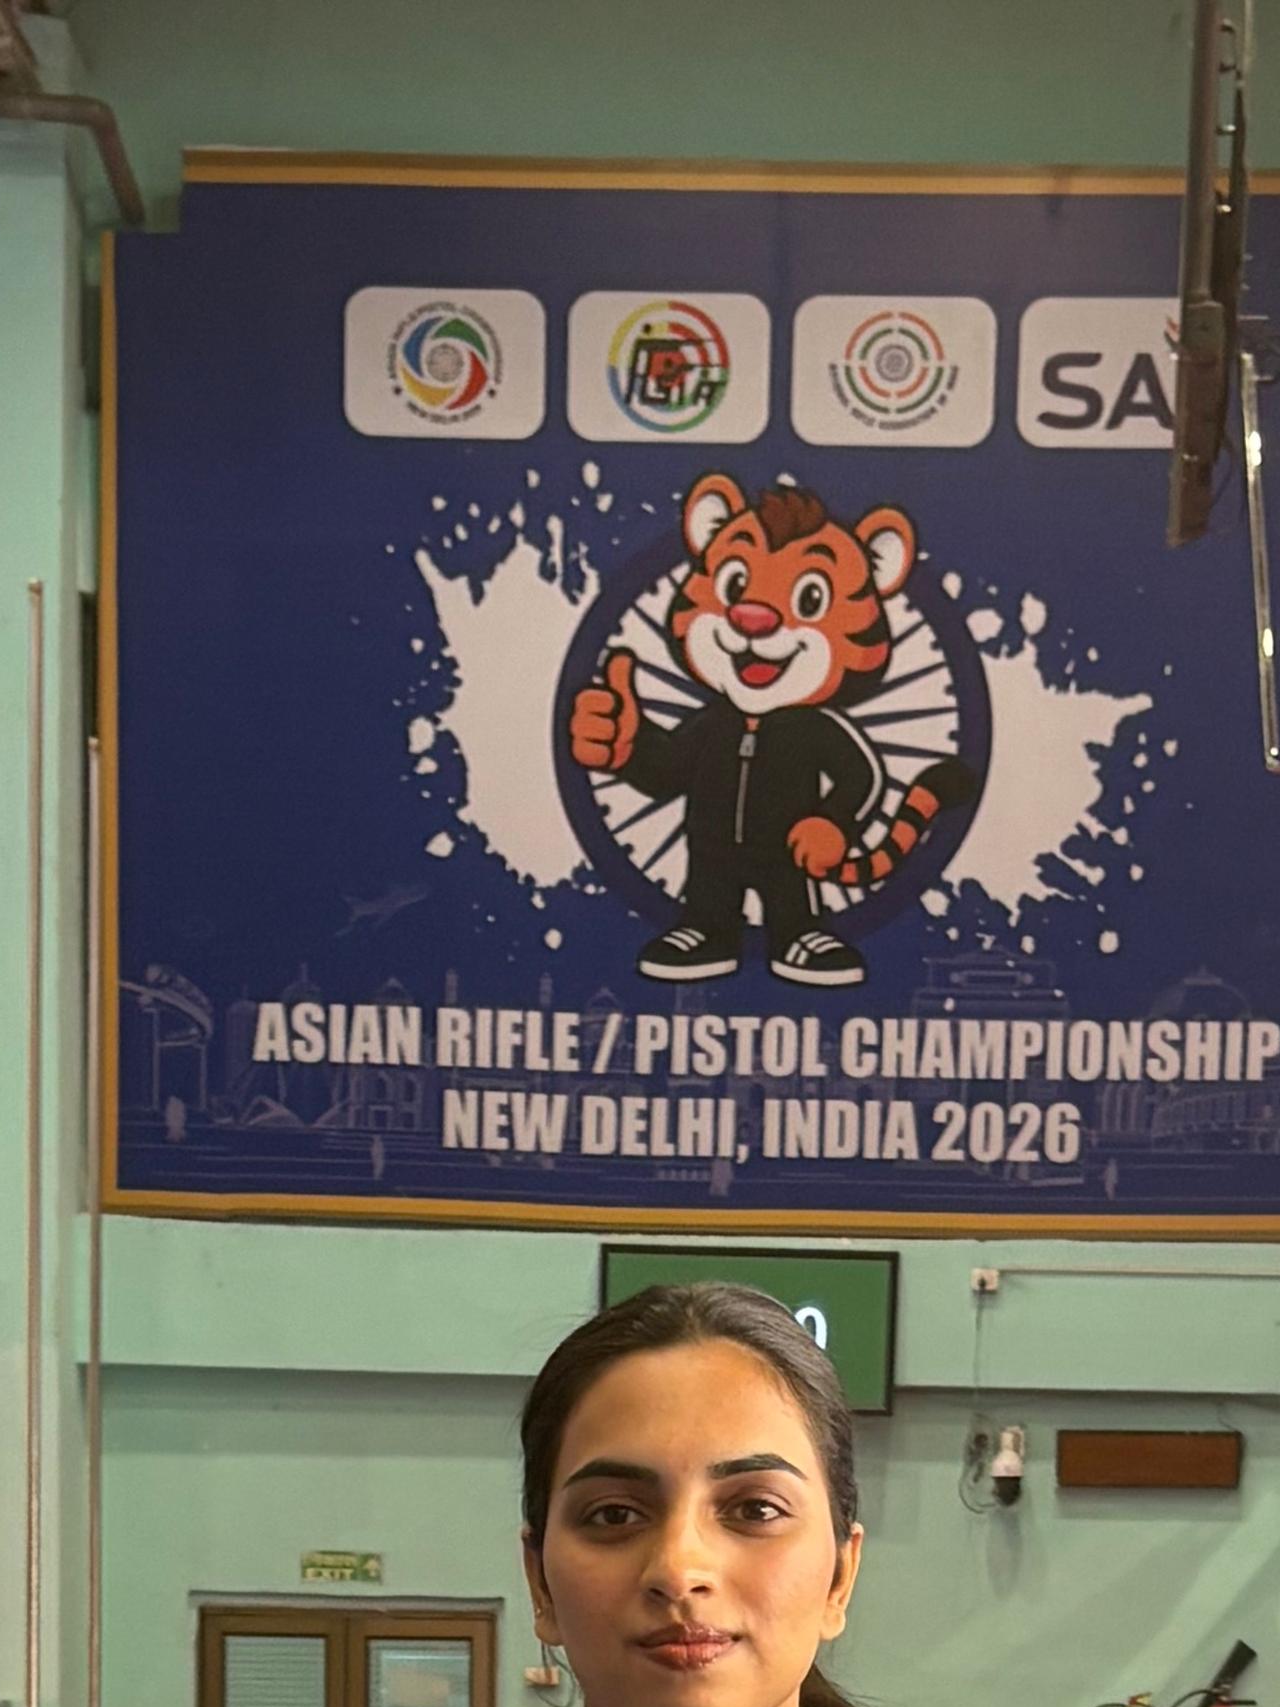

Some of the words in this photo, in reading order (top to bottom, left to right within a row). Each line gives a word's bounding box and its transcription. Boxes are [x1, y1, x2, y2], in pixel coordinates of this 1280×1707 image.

[252, 1002, 419, 1067] ASIAN
[436, 1007, 580, 1073] RIFLE
[591, 1013, 620, 1075] /
[634, 1013, 829, 1079] PISTOL
[442, 1089, 569, 1155] NEW
[580, 1095, 749, 1164] DELHI,
[761, 1098, 920, 1161] INDIA
[930, 1101, 1083, 1164] 2026
